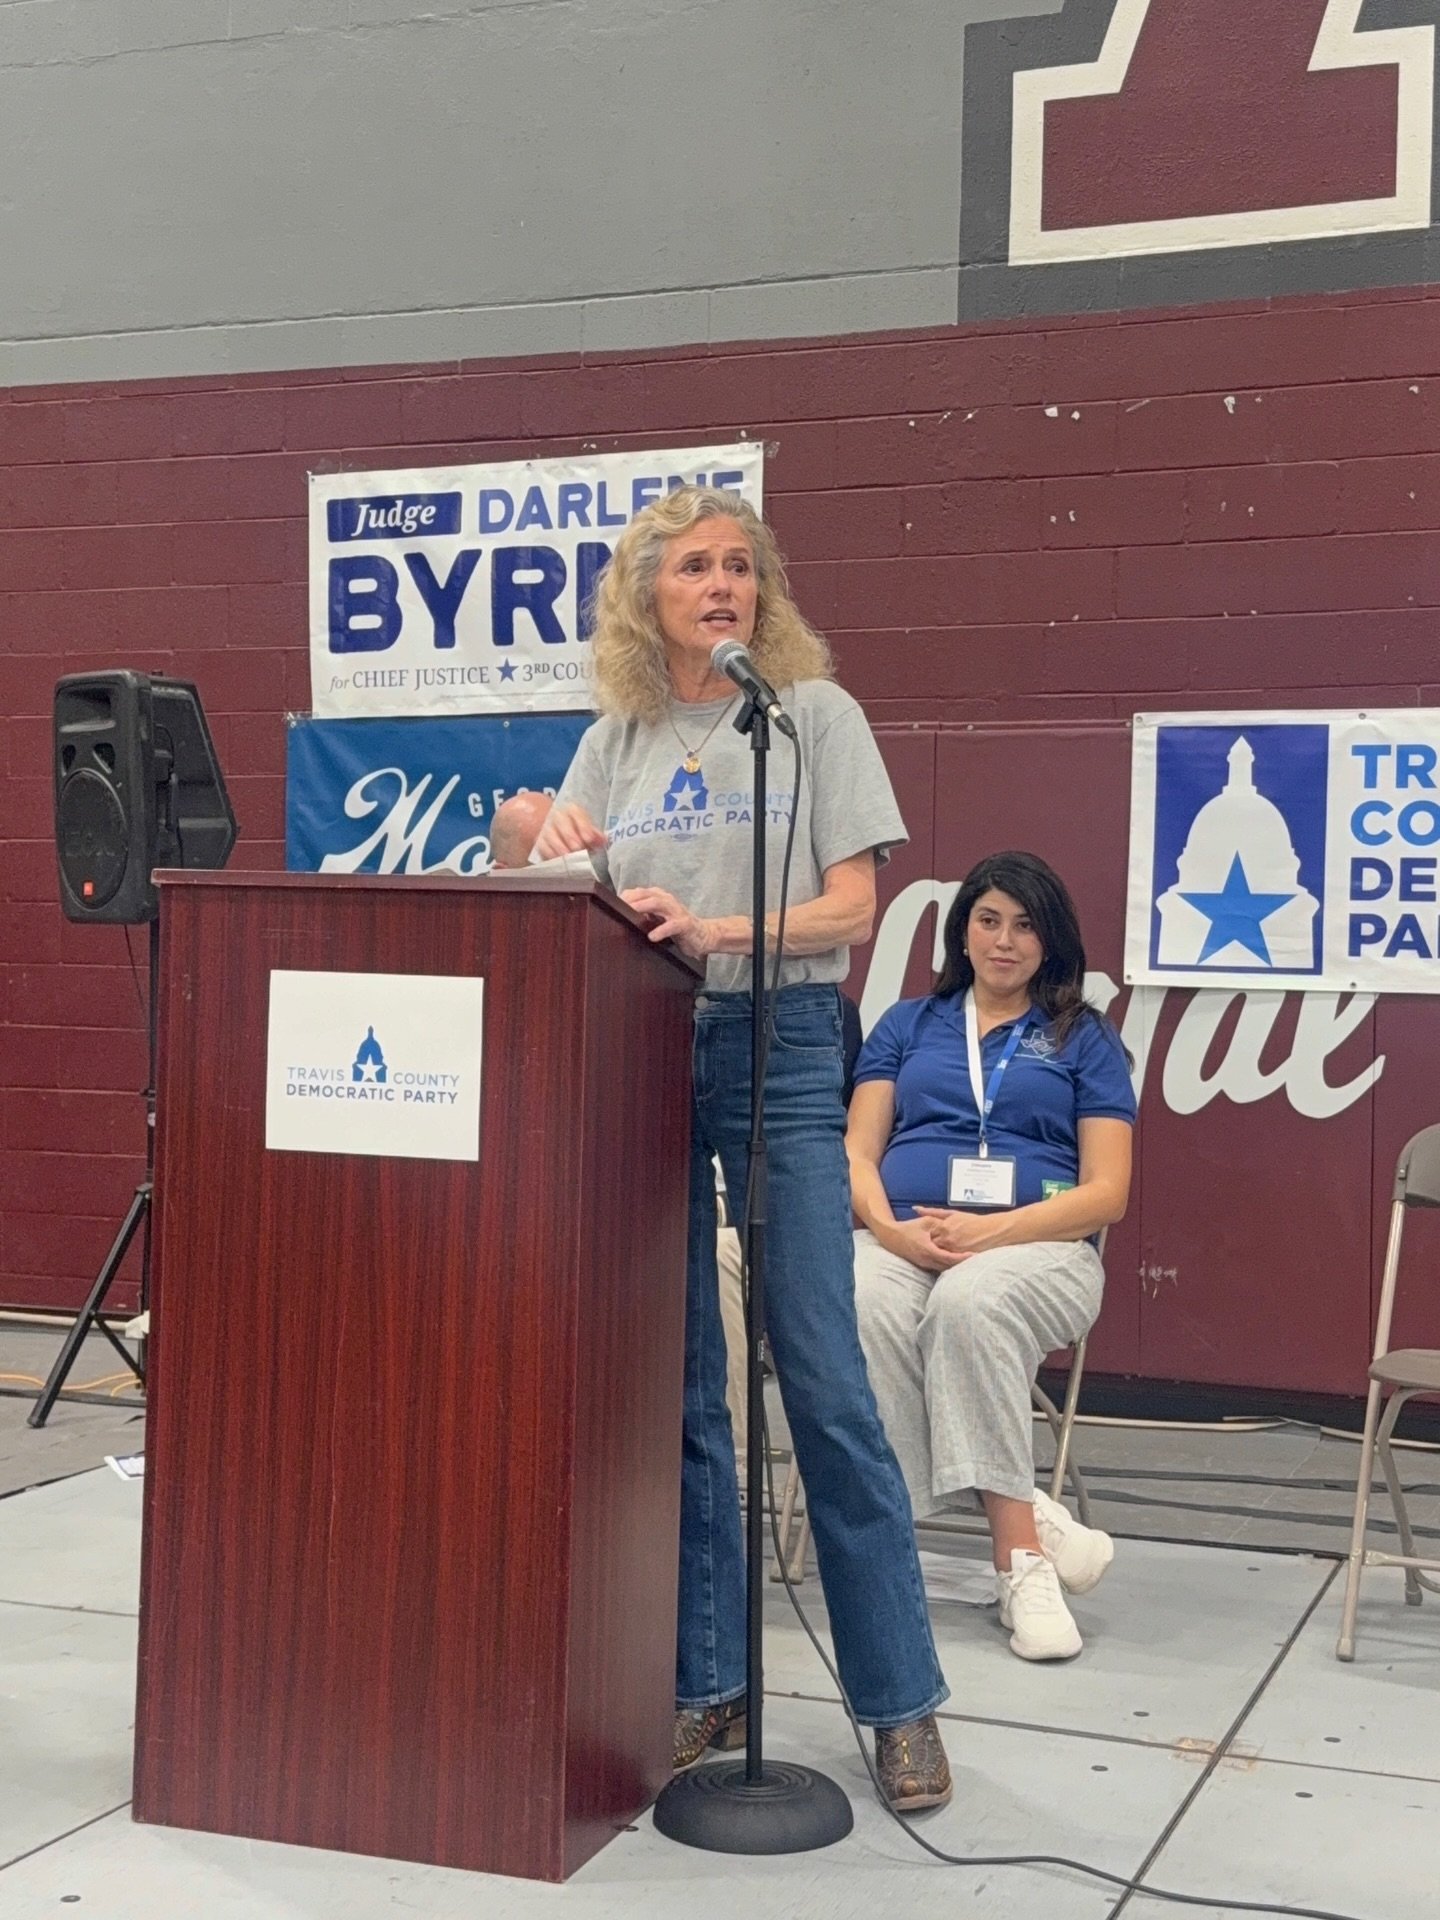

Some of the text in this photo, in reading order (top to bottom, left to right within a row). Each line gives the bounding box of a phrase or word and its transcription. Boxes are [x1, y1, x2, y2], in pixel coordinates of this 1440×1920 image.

[351, 501, 436, 537] Judge
[329, 676, 350, 693] for
[352, 669, 409, 689] CHIEF
[414, 666, 490, 690] JUSTICE
[553, 661, 592, 681] COU
[1348, 913, 1440, 959] PA
[287, 1067, 460, 1087] TRAVIS COUNTY
[286, 1083, 459, 1104] DEMOCRATIC PARTY
